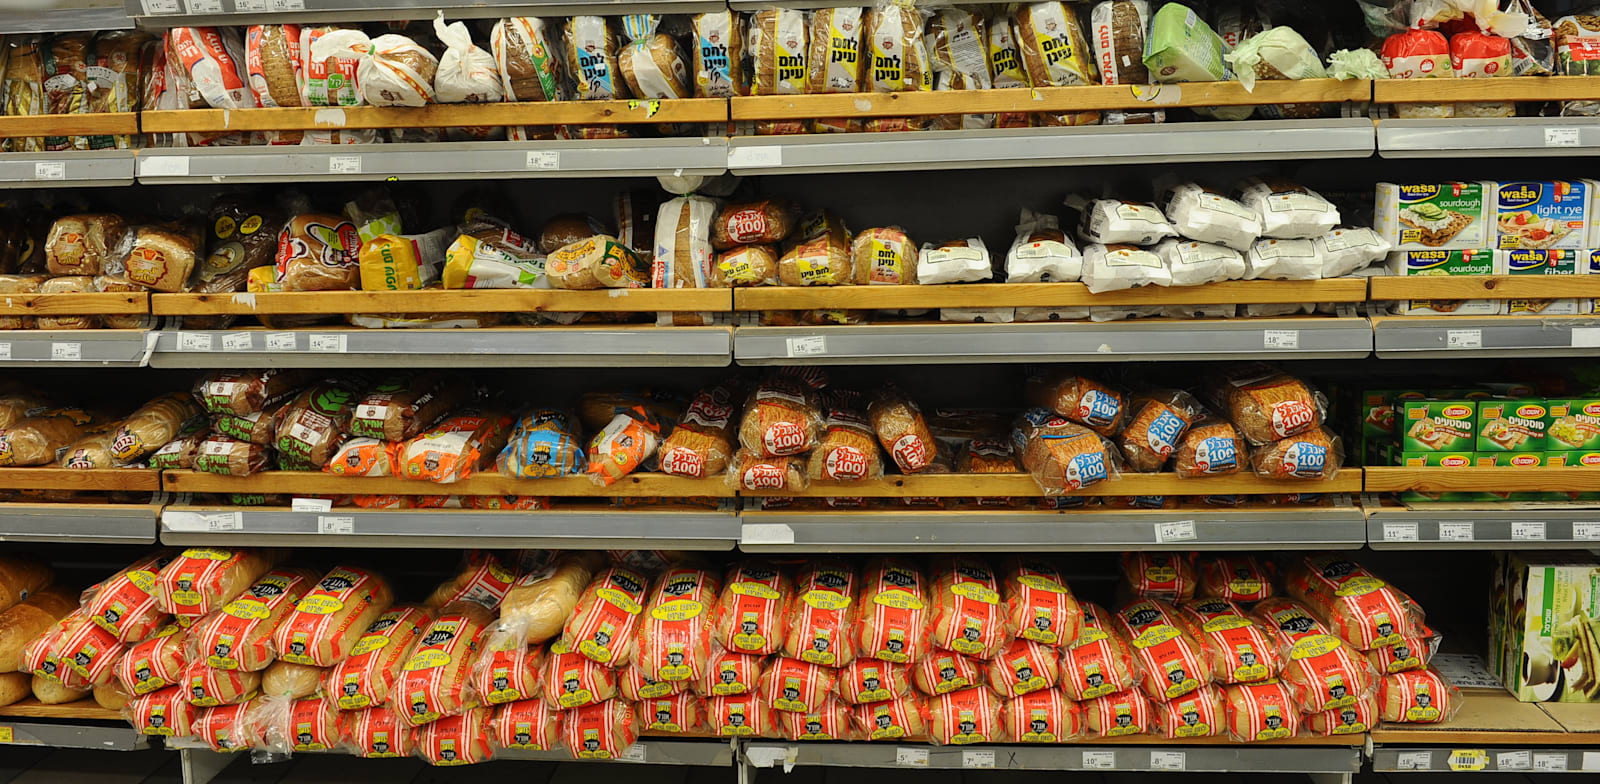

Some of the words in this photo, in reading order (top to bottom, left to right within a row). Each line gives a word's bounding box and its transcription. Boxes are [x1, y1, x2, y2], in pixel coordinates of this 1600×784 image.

[1041, 33, 1068, 52] לחם
[1098, 24, 1110, 48] לחם
[832, 36, 858, 50] לחם
[702, 44, 728, 58] לחם
[832, 50, 856, 63] עינן
[993, 47, 1016, 62] לחם
[1046, 47, 1072, 66] עינן
[580, 54, 604, 67] לחם
[704, 57, 727, 70] עינן
[779, 53, 804, 67] לחם
[875, 54, 901, 68] לחם
[780, 68, 804, 81] עינן
[875, 68, 900, 82] עינן
[1400, 184, 1436, 193] wasa
[1500, 189, 1536, 200] wasa
[1440, 199, 1481, 212] sourdough
[1537, 205, 1561, 216] light
[1564, 206, 1582, 215] rye
[738, 220, 764, 234] 100
[878, 250, 896, 258] לחם
[1410, 250, 1446, 260] wasa
[1512, 252, 1544, 262] wasa
[878, 258, 894, 268] עינן
[1449, 264, 1492, 275] sourdough
[1096, 391, 1118, 406] אנג'ל
[1094, 400, 1116, 416] 100
[1283, 411, 1309, 428] 100
[1434, 416, 1472, 430] טוסטעים
[1508, 416, 1545, 430] טוסטעים
[774, 423, 799, 436] אנג'ל
[1160, 418, 1180, 442] 100
[112, 436, 134, 454] ברמן
[775, 434, 801, 448] 100
[1208, 438, 1234, 449] אנג'ל
[1299, 442, 1325, 454] אנג'ל
[837, 448, 864, 463] אנג'ל
[1076, 453, 1102, 467] אנג'ל
[1209, 448, 1234, 462] 100
[1299, 454, 1324, 466] 100
[672, 462, 696, 474] 100
[836, 460, 862, 473] 100
[1079, 465, 1105, 480] 100
[755, 476, 780, 487] 100
[615, 576, 638, 589] אנג'ל
[668, 582, 693, 592] אנג'ל
[736, 583, 756, 591] אחיד
[956, 584, 977, 592] אחיד
[602, 590, 624, 600] אחיד
[809, 592, 828, 600] אחיד
[879, 592, 898, 600] אחיד
[900, 594, 919, 604] לחם
[966, 592, 986, 600] פרוס
[680, 603, 698, 611] לחם
[888, 600, 909, 608] פרוס
[1150, 635, 1167, 645] פרוס
[1294, 640, 1314, 651] אחיד
[1315, 636, 1334, 644] לחם
[1308, 646, 1328, 656] פרוס
